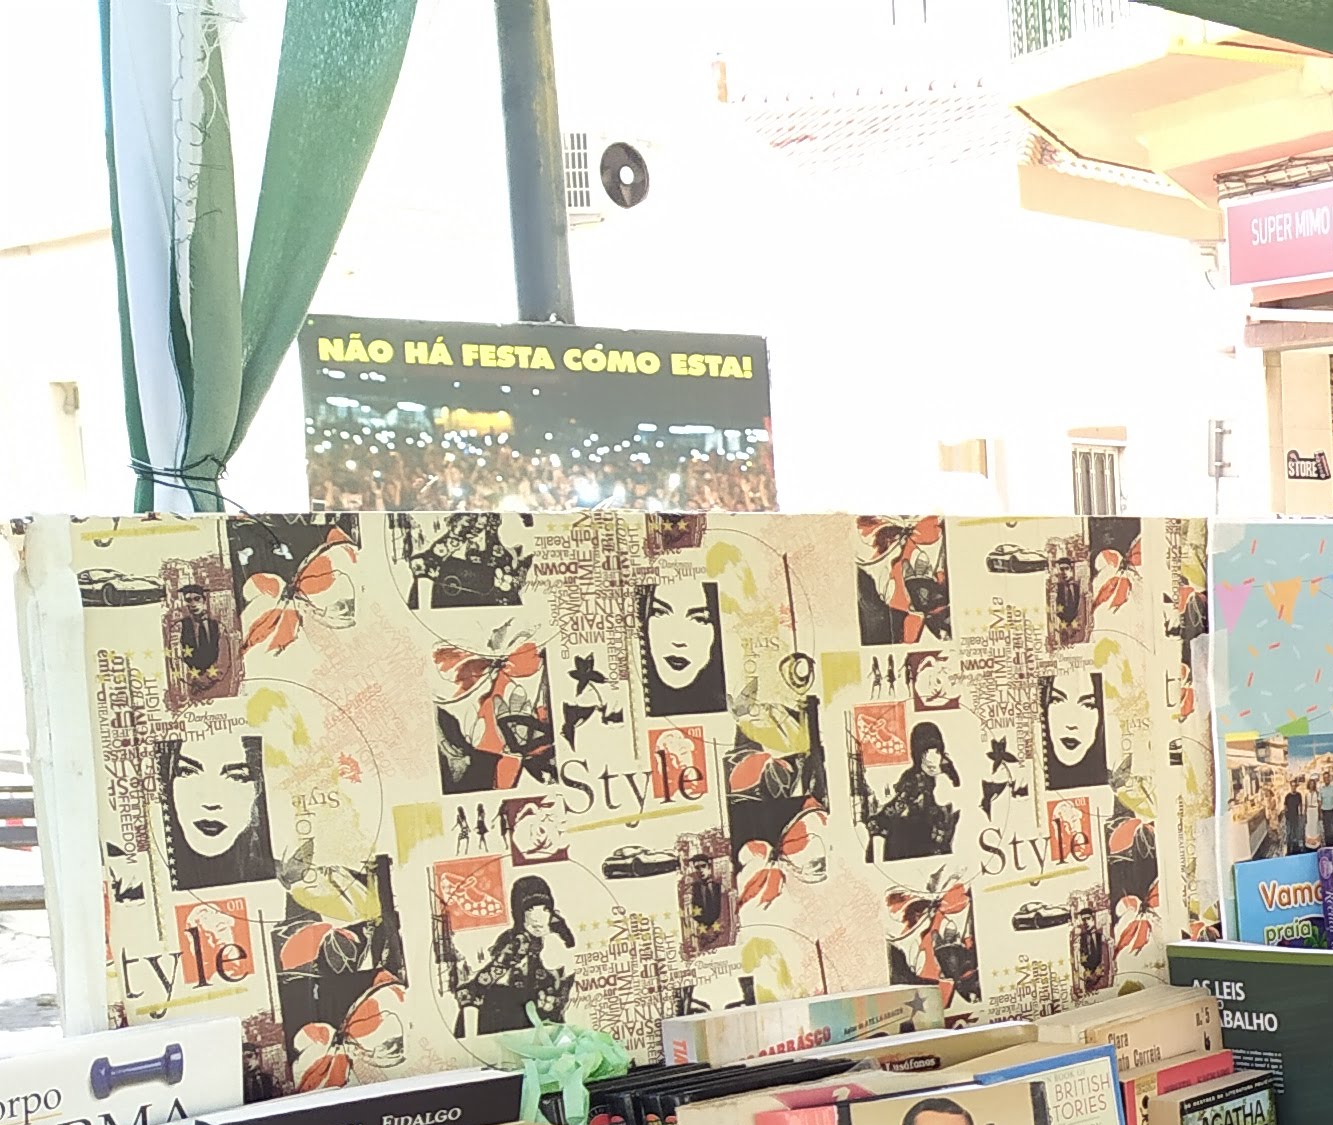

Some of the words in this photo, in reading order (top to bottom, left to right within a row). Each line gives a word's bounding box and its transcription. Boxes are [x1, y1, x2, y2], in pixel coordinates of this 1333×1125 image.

[1252, 213, 1292, 245] SUPER
[1295, 206, 1330, 238] MIMO
[318, 332, 393, 363] NÃO
[404, 335, 453, 367] HÁ
[462, 343, 555, 371] FESTA
[671, 353, 753, 378] ESTA!
[1288, 460, 1319, 477] STORE
[534, 562, 579, 576] DOWN
[568, 631, 606, 646] MIND
[560, 754, 706, 825] Style
[978, 820, 1091, 890] Style
[1264, 919, 1312, 945] praia
[122, 925, 249, 1018] tyle
[575, 974, 618, 992] DOWN
[1216, 980, 1246, 1001] LEIS
[1134, 1045, 1162, 1069] Correia
[1055, 1072, 1111, 1102] BRITISH
[0, 1088, 62, 1125] orpo
